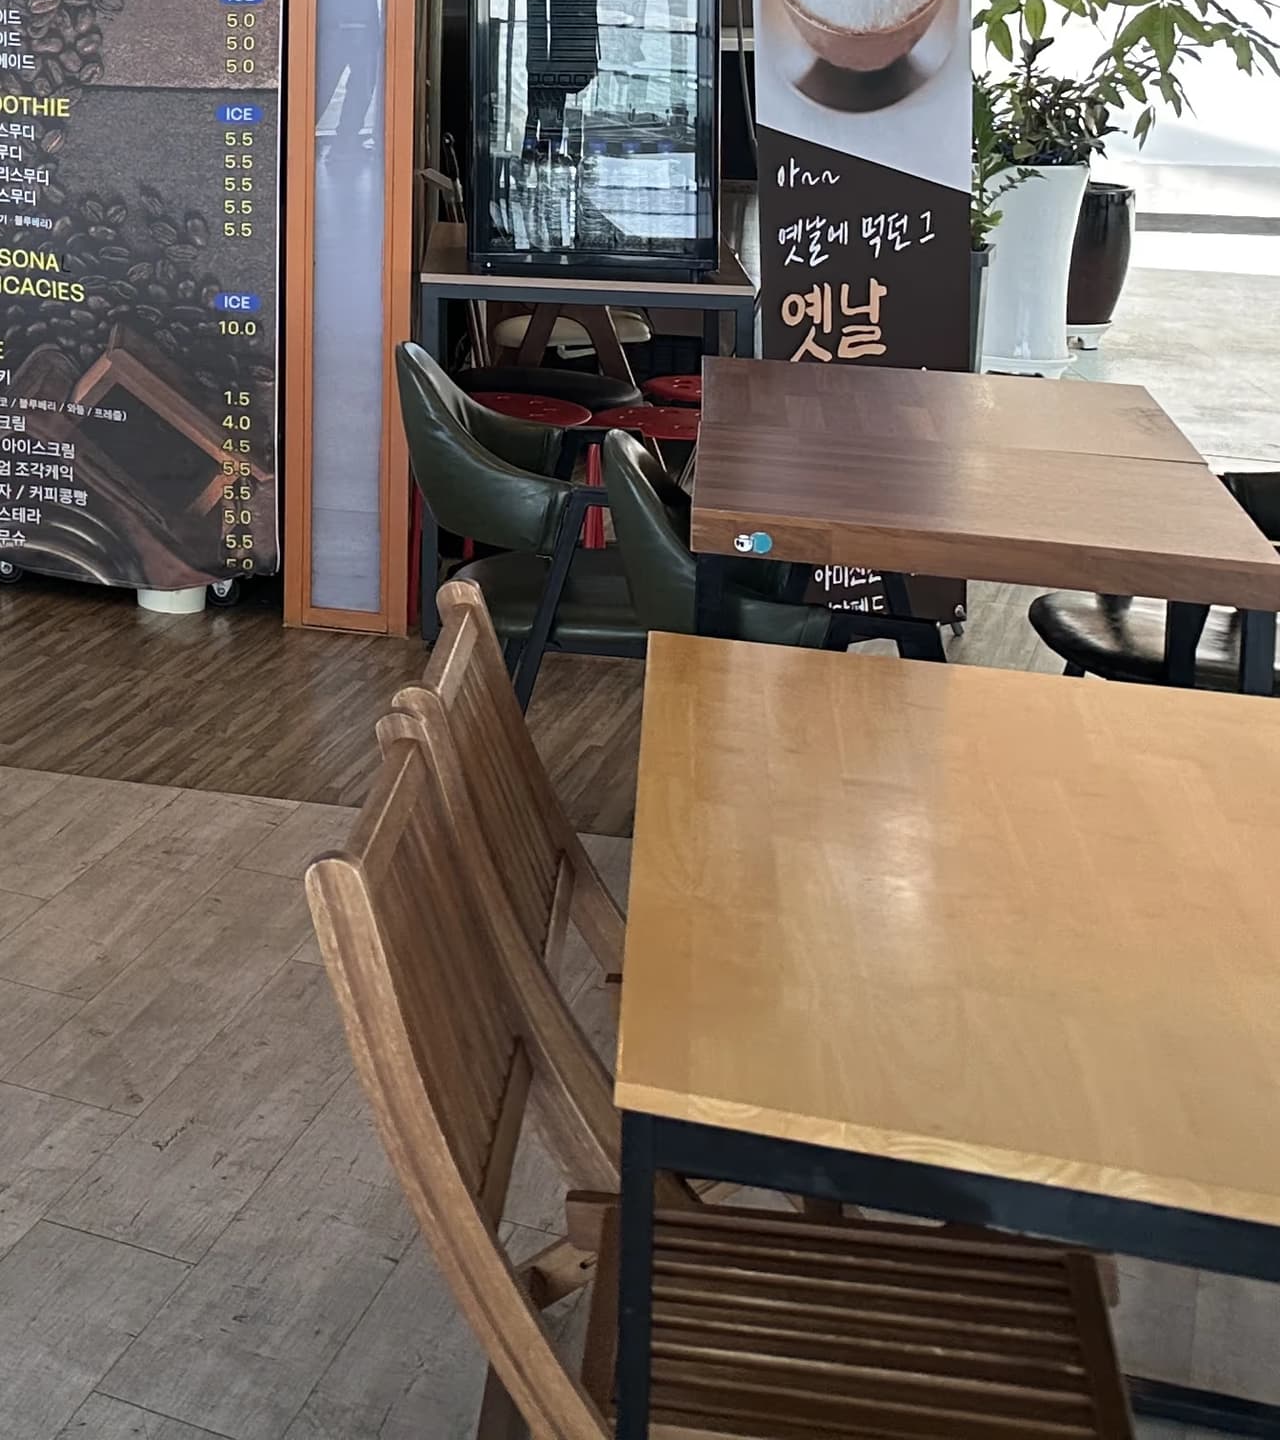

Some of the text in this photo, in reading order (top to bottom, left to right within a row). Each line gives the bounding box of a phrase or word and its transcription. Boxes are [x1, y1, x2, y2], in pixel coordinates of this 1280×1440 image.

[227, 14, 255, 28] 5.0
[226, 37, 255, 51] 5.0
[226, 59, 255, 74] 5.0
[226, 107, 253, 121] ICE
[225, 132, 253, 147] 5.5
[225, 155, 253, 169] 5.5
[225, 177, 252, 192] 5.5
[224, 200, 252, 214] 5.5
[224, 222, 252, 237] 5.5
[778, 211, 938, 267] 옛날에 먹던 그
[224, 295, 250, 310] ICE
[781, 277, 888, 362] 옛날
[218, 321, 256, 336] 10.0
[224, 391, 250, 406] 1.5
[222, 415, 251, 430] 4.0
[222, 439, 251, 453] 4.5
[2, 438, 75, 460] 아이스크림
[223, 462, 251, 476] 5.5
[15, 462, 74, 482] 조각케익
[223, 486, 251, 501] 5.5
[29, 485, 88, 507] 커피콩빵
[224, 510, 252, 525] 5.0
[225, 534, 253, 549] 5.5
